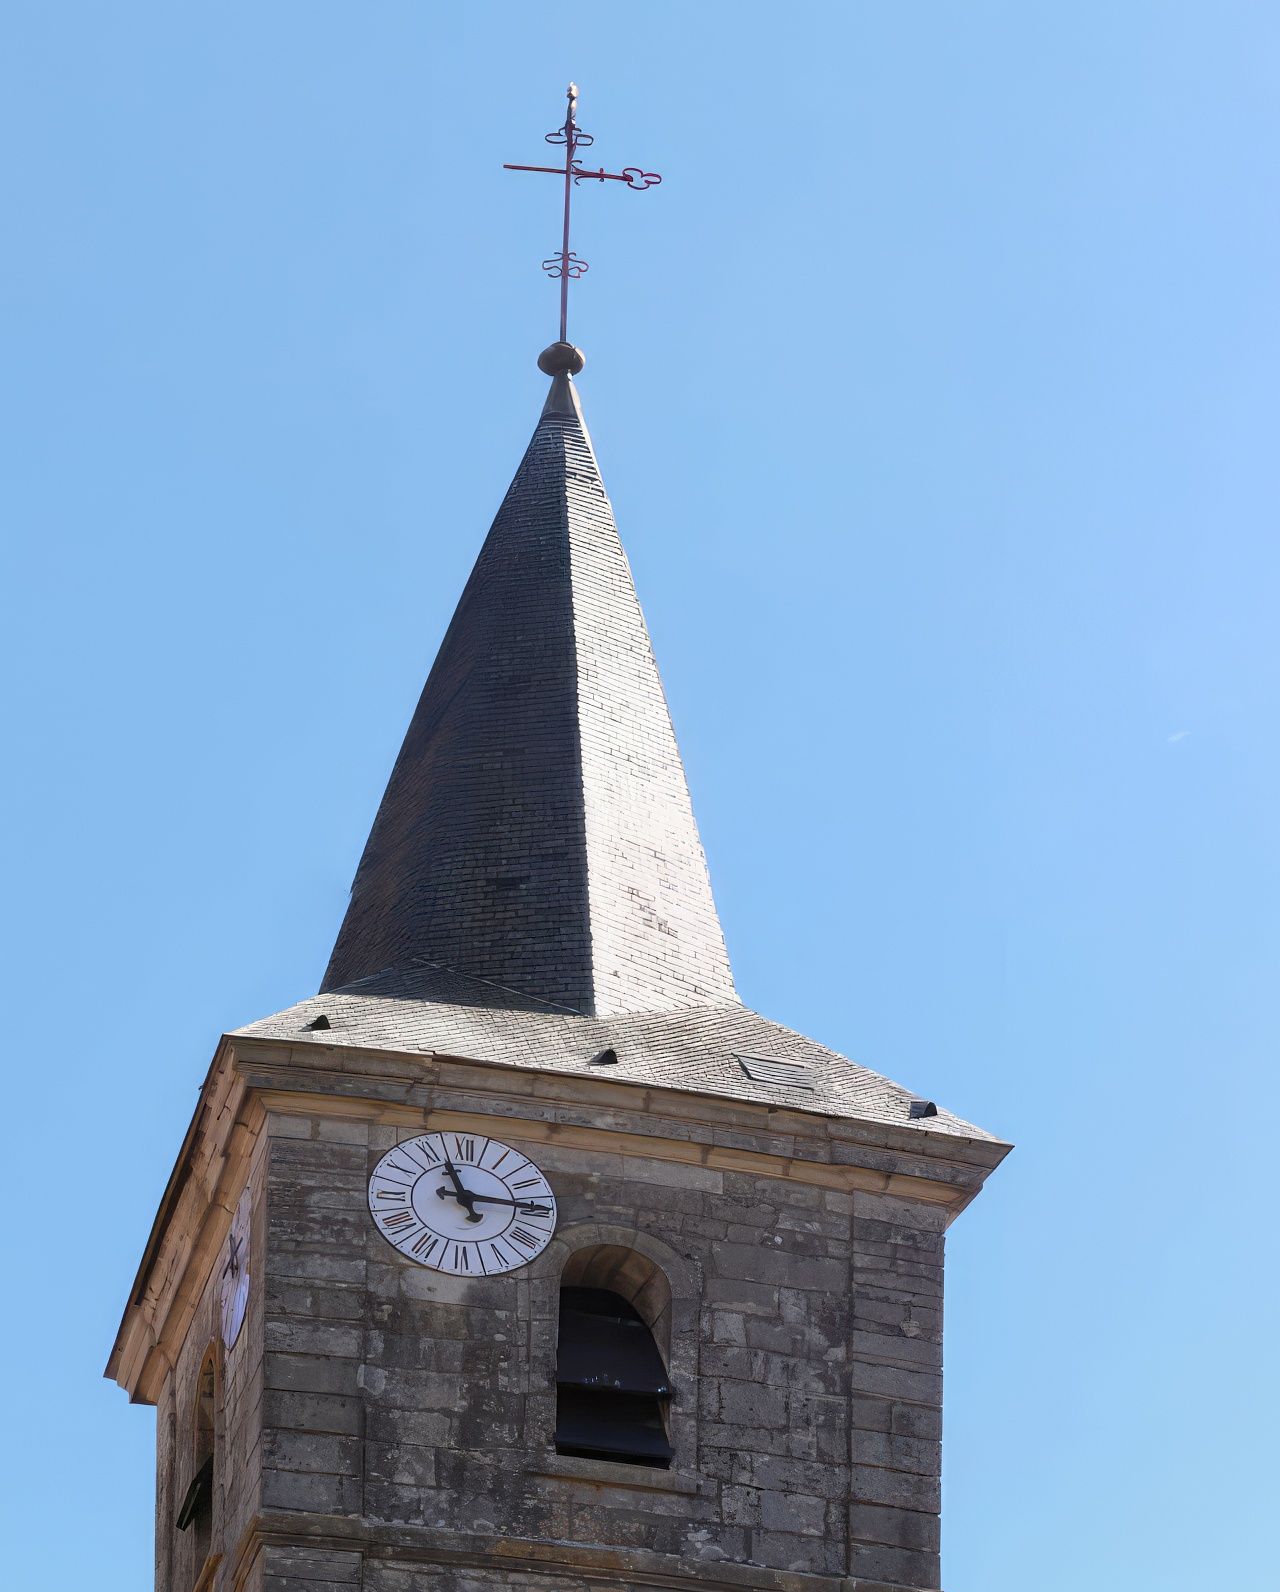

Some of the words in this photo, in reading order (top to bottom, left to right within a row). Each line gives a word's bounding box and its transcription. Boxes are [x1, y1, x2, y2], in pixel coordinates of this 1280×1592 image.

[455, 1135, 474, 1161] XII
[492, 1149, 510, 1170] I
[512, 1178, 541, 1189] II
[411, 1232, 439, 1258] VII
[490, 1243, 509, 1267] V
